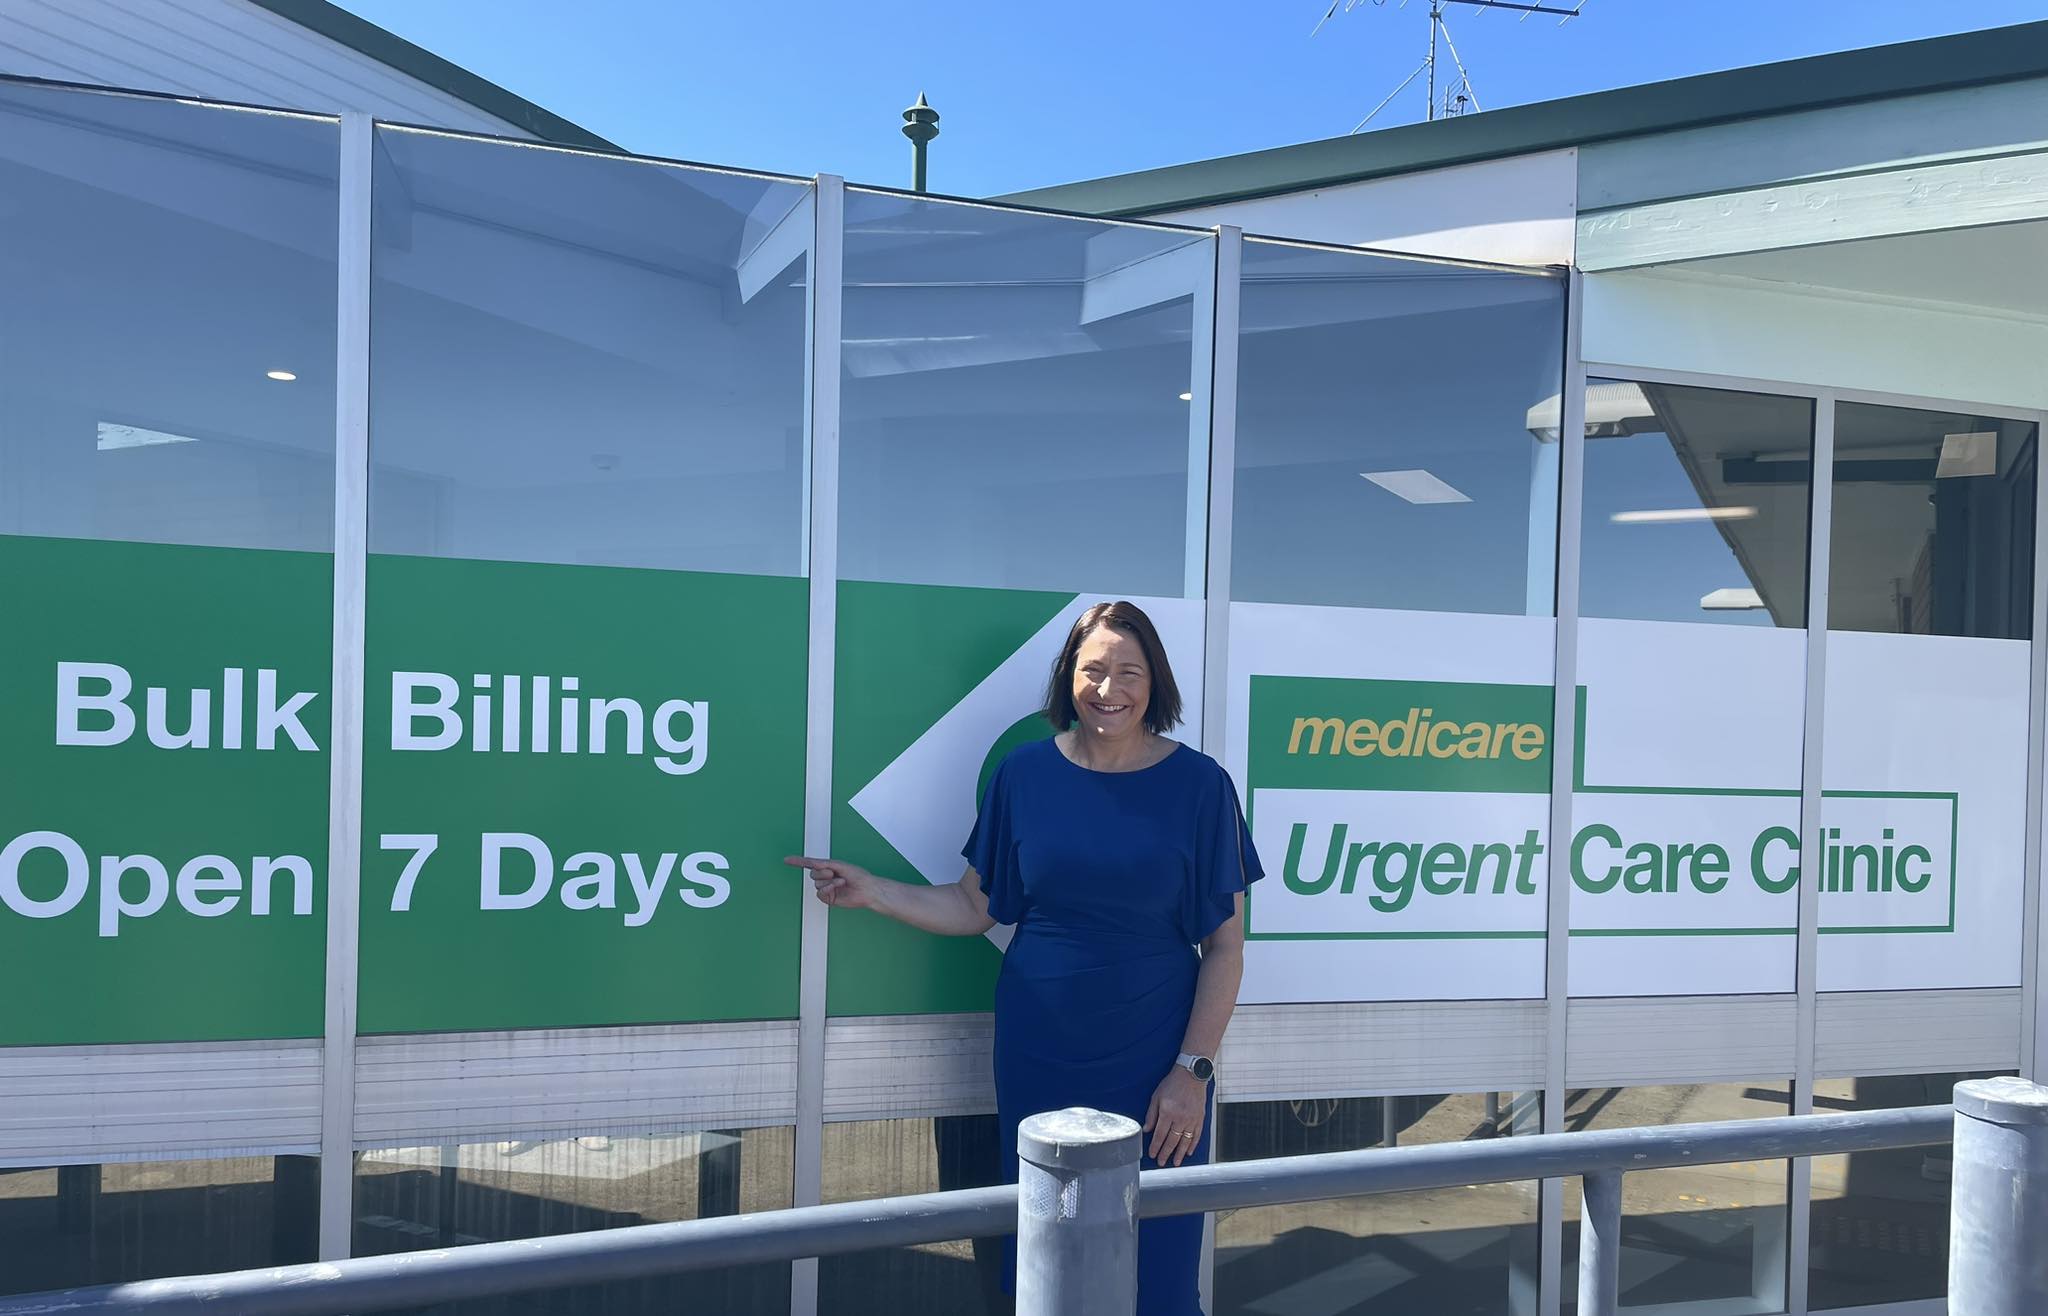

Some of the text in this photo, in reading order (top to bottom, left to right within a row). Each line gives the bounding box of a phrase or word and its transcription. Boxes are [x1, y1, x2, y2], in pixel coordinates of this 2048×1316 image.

[56, 661, 709, 775] Bulk Billing
[1287, 708, 1545, 761] medicare
[0, 830, 731, 937] Open 7 Days
[1283, 822, 1544, 913] Urgent
[1569, 824, 1729, 894] Care
